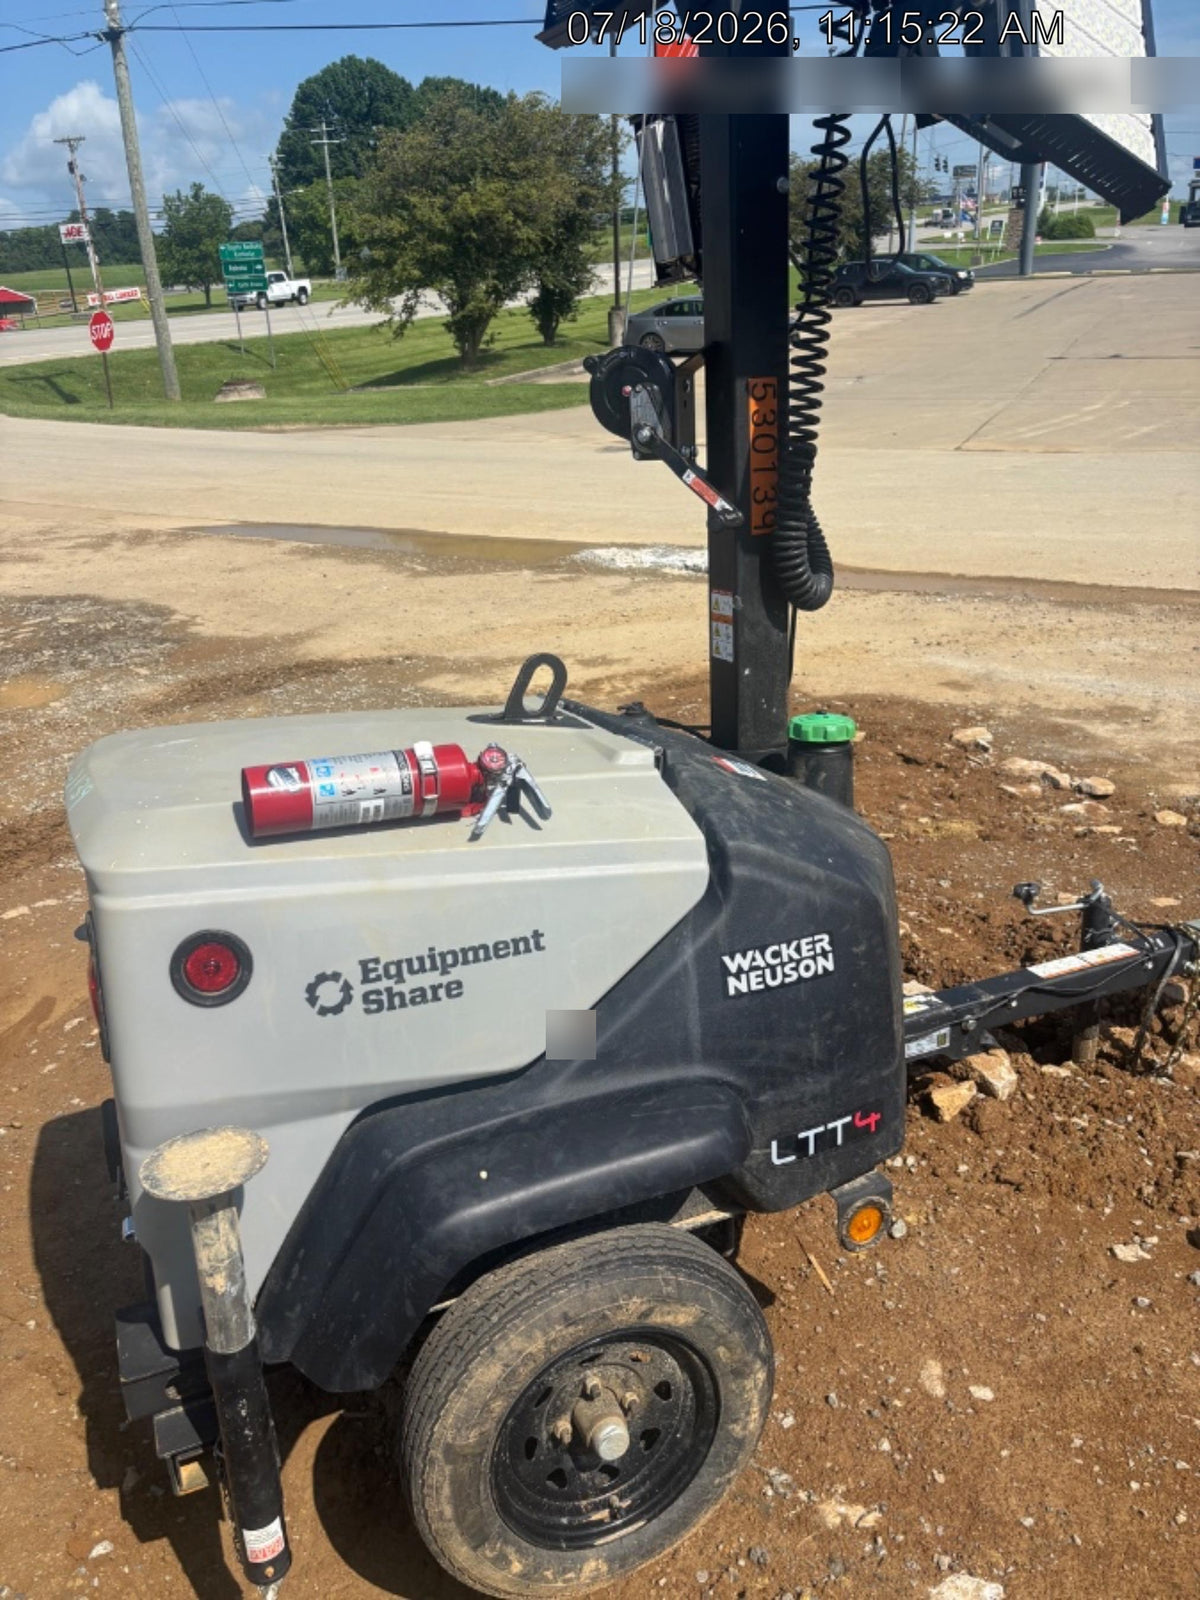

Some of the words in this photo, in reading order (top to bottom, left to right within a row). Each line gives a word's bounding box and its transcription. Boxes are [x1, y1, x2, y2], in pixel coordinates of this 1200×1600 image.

[91, 322, 112, 340] STOP
[751, 380, 778, 531] 530139
[358, 929, 546, 985] Equipment
[721, 932, 833, 974] WACKER
[727, 952, 835, 997] NEUSON
[361, 978, 464, 1015] Share
[771, 1111, 881, 1166] LTT4
